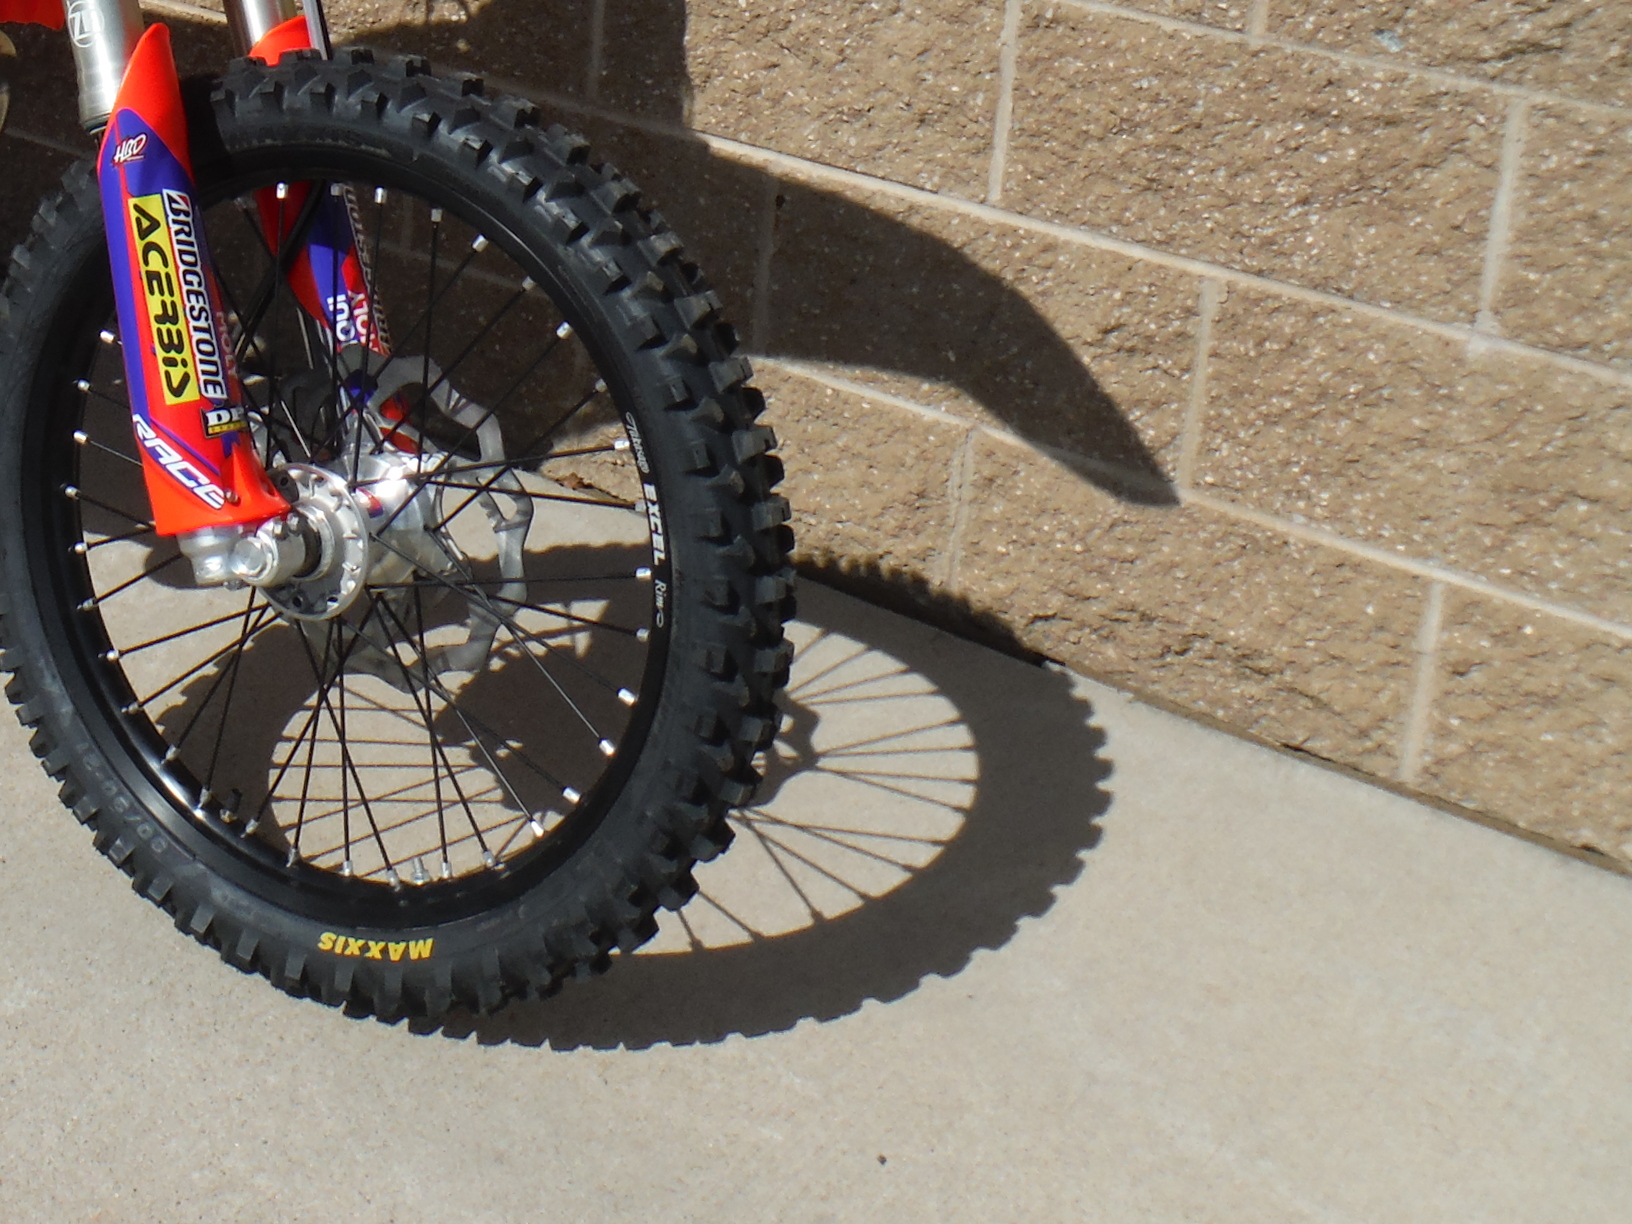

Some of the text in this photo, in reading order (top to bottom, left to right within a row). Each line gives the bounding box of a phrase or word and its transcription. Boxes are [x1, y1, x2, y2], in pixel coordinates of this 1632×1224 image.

[164, 190, 227, 398] BRIDGESTONE
[132, 413, 227, 510] RACE
[643, 483, 667, 566] EXCEL
[317, 931, 435, 962] MAXXIS
